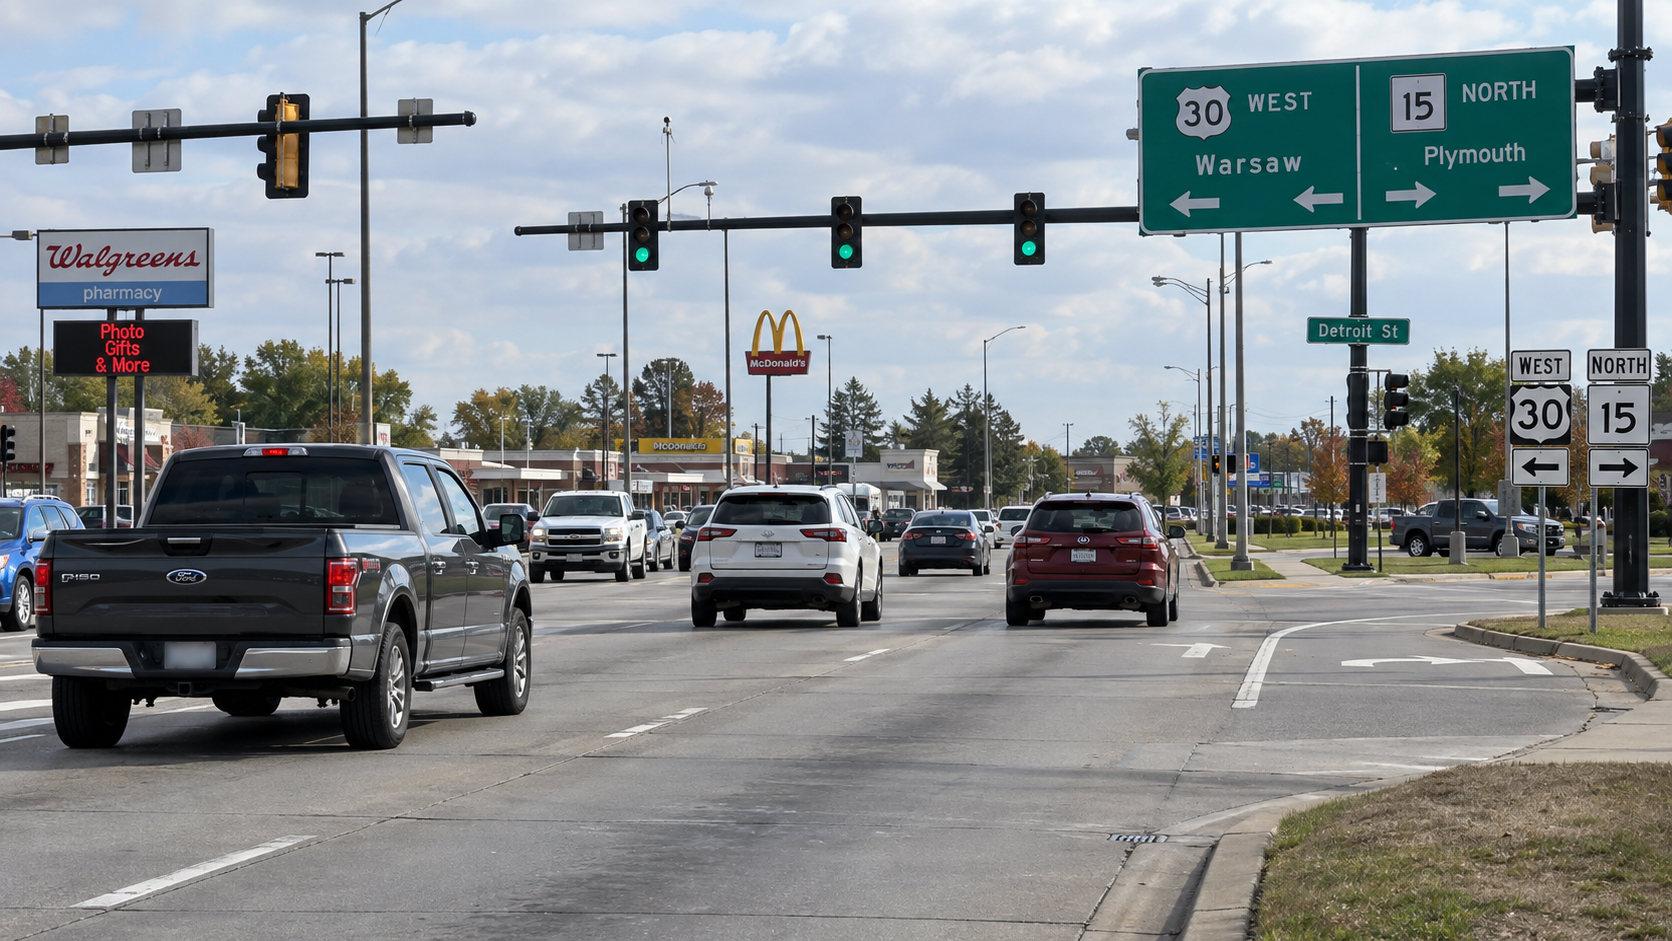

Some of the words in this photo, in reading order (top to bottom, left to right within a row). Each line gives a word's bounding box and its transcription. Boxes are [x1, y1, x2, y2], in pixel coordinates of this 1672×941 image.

[1247, 91, 1312, 113] WEST
[1462, 80, 1536, 103] NORTH
[1184, 100, 1223, 128] 30
[1402, 91, 1434, 121] 15
[1195, 154, 1302, 177] Warsaw
[1424, 142, 1526, 170] Plymouth
[46, 244, 200, 277] Walgreens
[83, 286, 162, 303] pharmacy
[100, 323, 144, 340] Photo
[1319, 323, 1372, 339] Detroit
[1382, 323, 1398, 339] St
[105, 340, 140, 356] Gifts
[96, 357, 107, 373] &
[112, 357, 150, 373] More
[750, 358, 806, 369] McDonald's
[1519, 356, 1563, 375] WEST
[1591, 356, 1647, 375] NORTH
[1517, 399, 1563, 430] 30
[1602, 402, 1637, 434] 15
